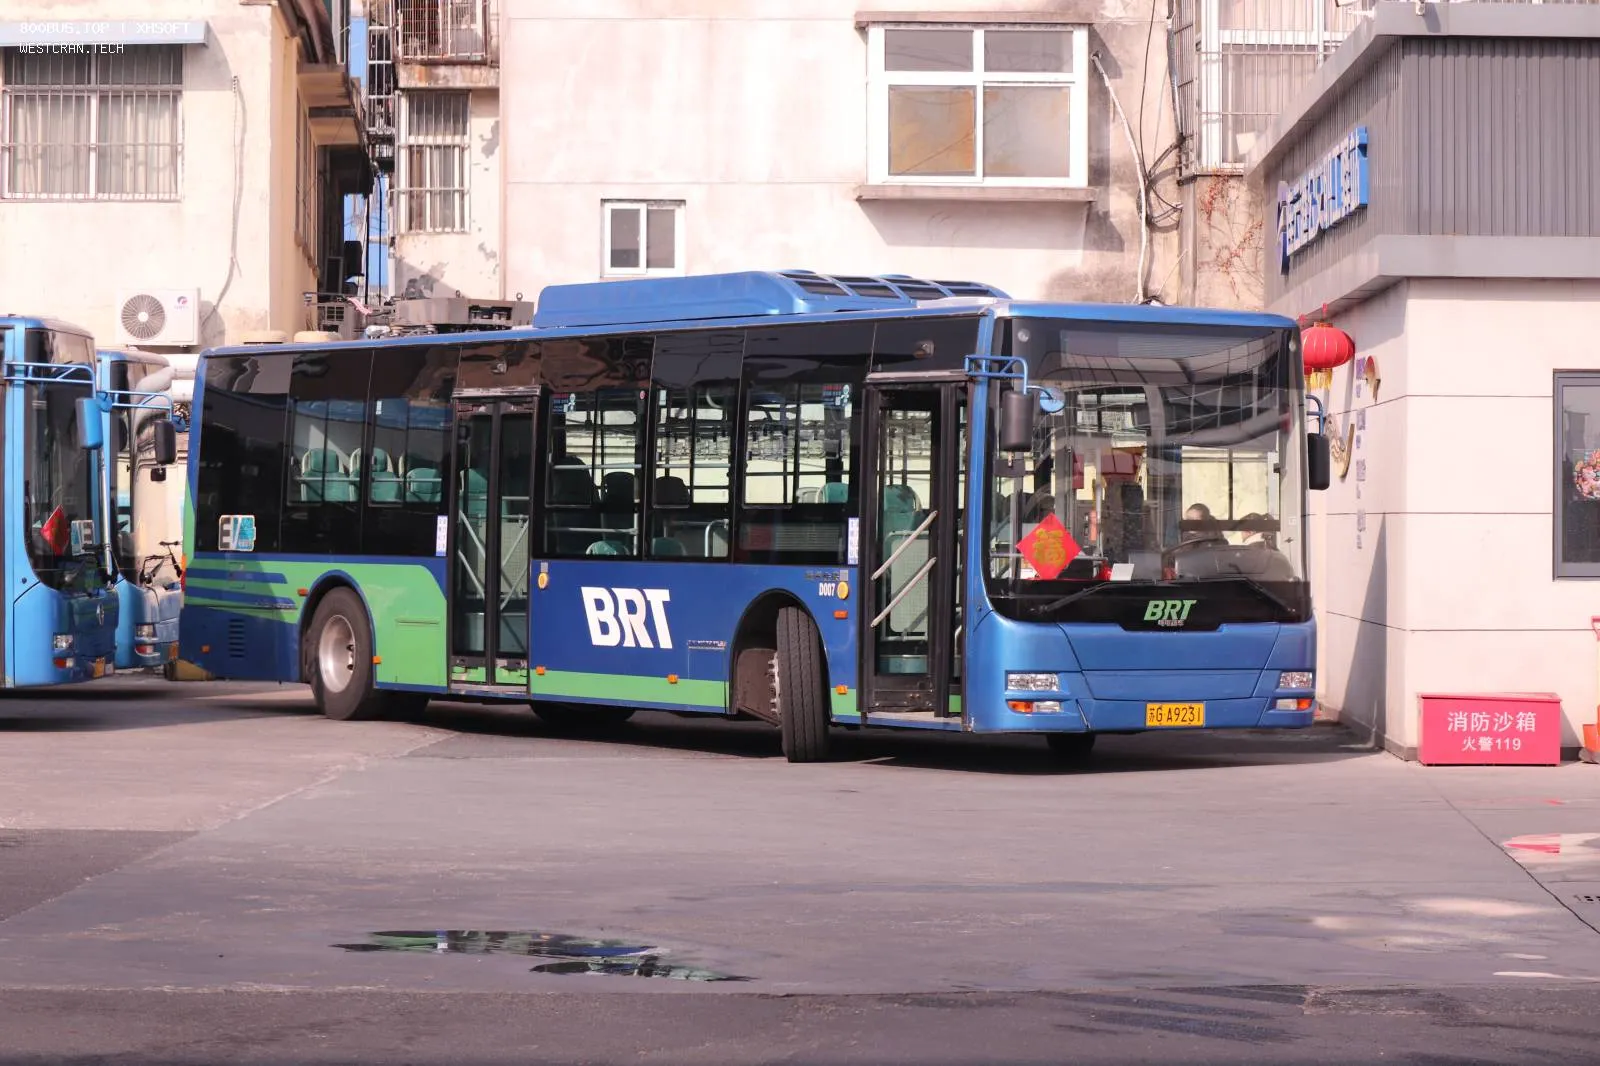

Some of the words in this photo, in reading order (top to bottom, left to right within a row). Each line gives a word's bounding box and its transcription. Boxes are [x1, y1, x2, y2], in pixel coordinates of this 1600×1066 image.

[580, 586, 673, 649] BRT
[1143, 599, 1198, 621] BRT
[1447, 711, 1537, 733] 消防沙箱
[1461, 736, 1522, 752] 火警119
